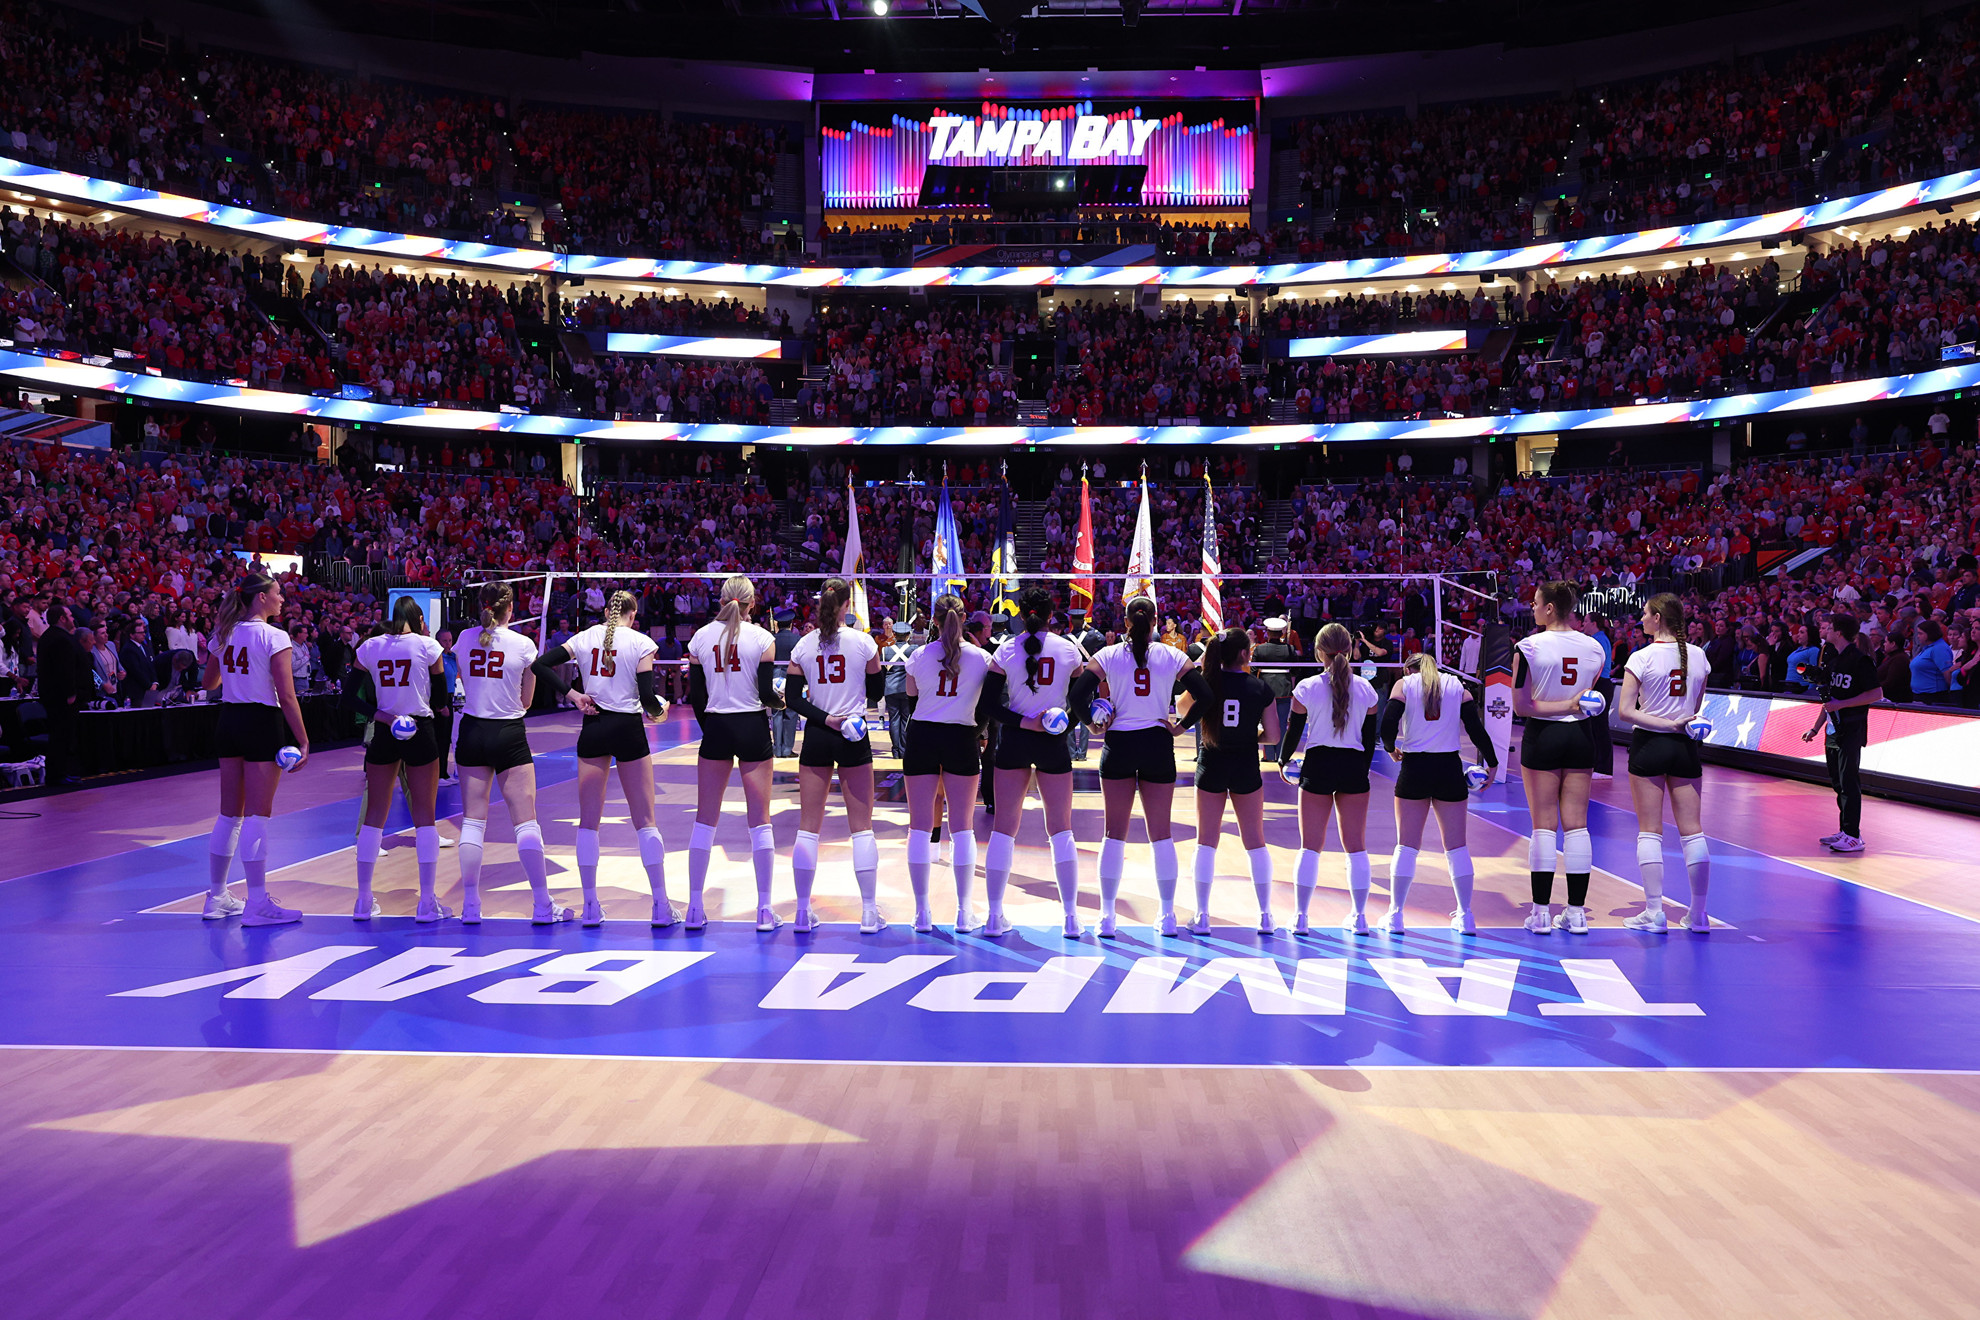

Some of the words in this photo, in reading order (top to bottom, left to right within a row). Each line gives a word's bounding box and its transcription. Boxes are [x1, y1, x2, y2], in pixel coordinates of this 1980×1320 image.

[928, 116, 1063, 160] TAMPA
[1068, 115, 1161, 159] BAY
[223, 645, 249, 675] 44
[377, 659, 412, 687] 27
[469, 649, 505, 679] 22
[590, 648, 617, 678] 15
[713, 644, 741, 673] 14
[816, 654, 846, 684] 13
[1561, 657, 1578, 686] 5
[936, 670, 960, 697] 11
[1134, 667, 1150, 696] 9
[1669, 669, 1687, 697] 2
[1223, 699, 1240, 727] 8
[105, 946, 716, 1006] BAY
[757, 951, 1705, 1017] TAMPA
